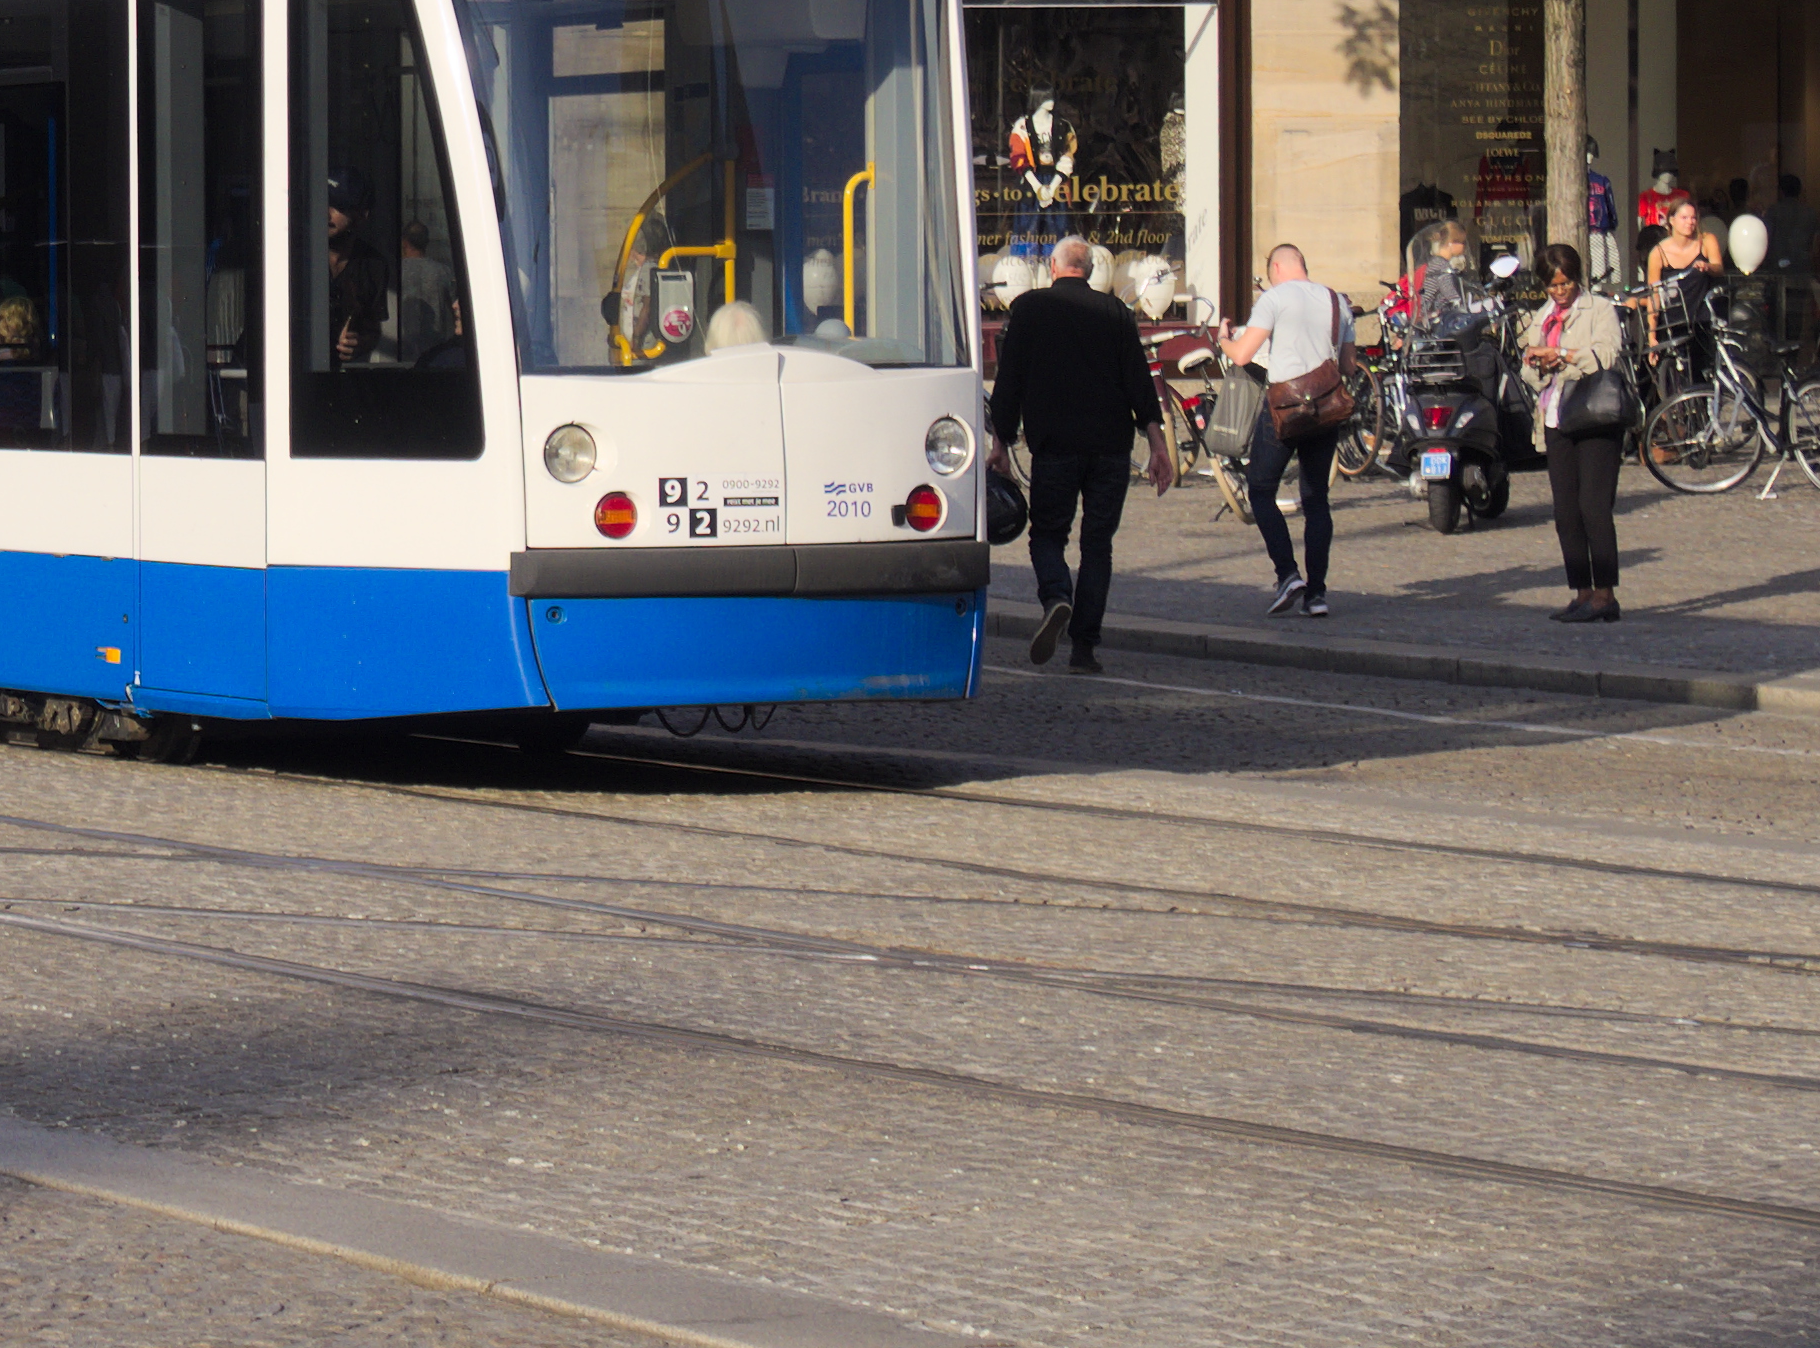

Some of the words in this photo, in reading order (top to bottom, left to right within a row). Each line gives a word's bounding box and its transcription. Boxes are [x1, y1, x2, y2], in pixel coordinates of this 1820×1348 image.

[1463, 174, 1545, 183] SMYTHSON
[1002, 186, 1023, 201] to
[1002, 230, 1057, 247] fashion
[1087, 230, 1101, 245] &
[1105, 229, 1134, 245] 2nd
[1135, 228, 1173, 248] floor
[664, 479, 682, 504] 9
[696, 481, 710, 501] 2
[722, 479, 780, 489] 0900-9292
[848, 482, 874, 494] GVB
[827, 500, 872, 517] 2010
[667, 513, 681, 534] 9
[695, 510, 712, 535] 2
[723, 515, 780, 533] 9292.nl
